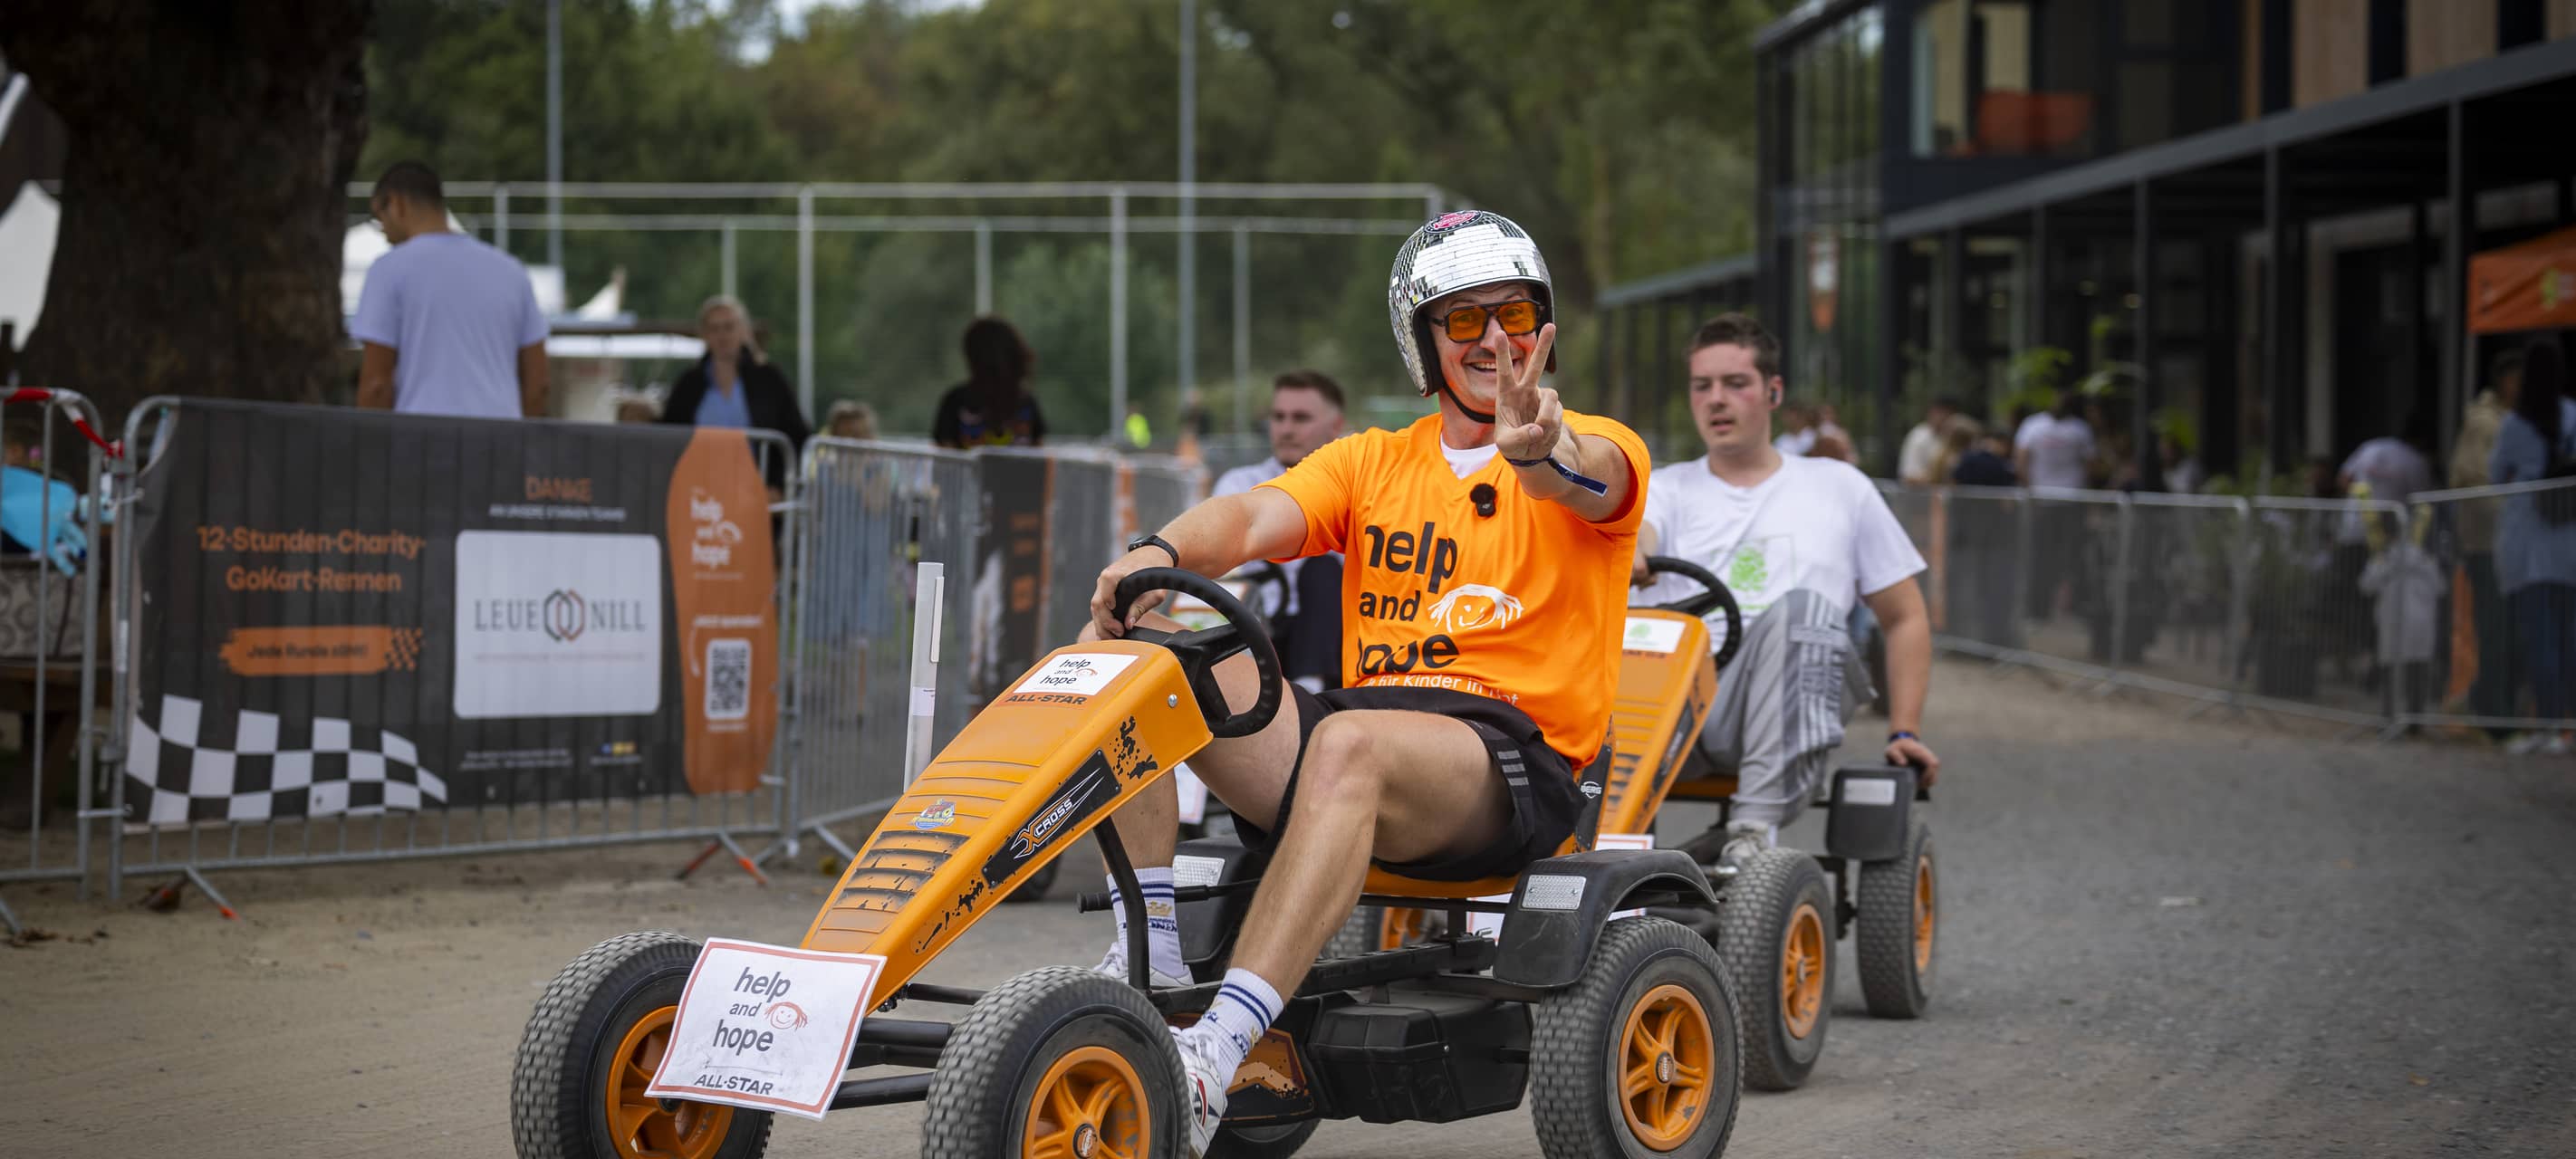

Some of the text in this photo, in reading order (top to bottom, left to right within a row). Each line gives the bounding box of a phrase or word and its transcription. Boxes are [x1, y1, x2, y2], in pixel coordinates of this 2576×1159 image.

[197, 526, 426, 560] 12-Stunden-Charity-
[226, 565, 401, 592] GoKart-Rennen
[475, 599, 647, 631] LEUE NILL
[1359, 590, 1420, 622] and
[1059, 658, 1091, 669] help
[1356, 634, 1460, 677] oe
[1040, 675, 1077, 686] hope
[1404, 674, 1462, 689] Kinder
[1466, 677, 1483, 694] in
[733, 966, 791, 1002] help
[729, 1001, 762, 1017] and
[712, 1019, 774, 1056] hope
